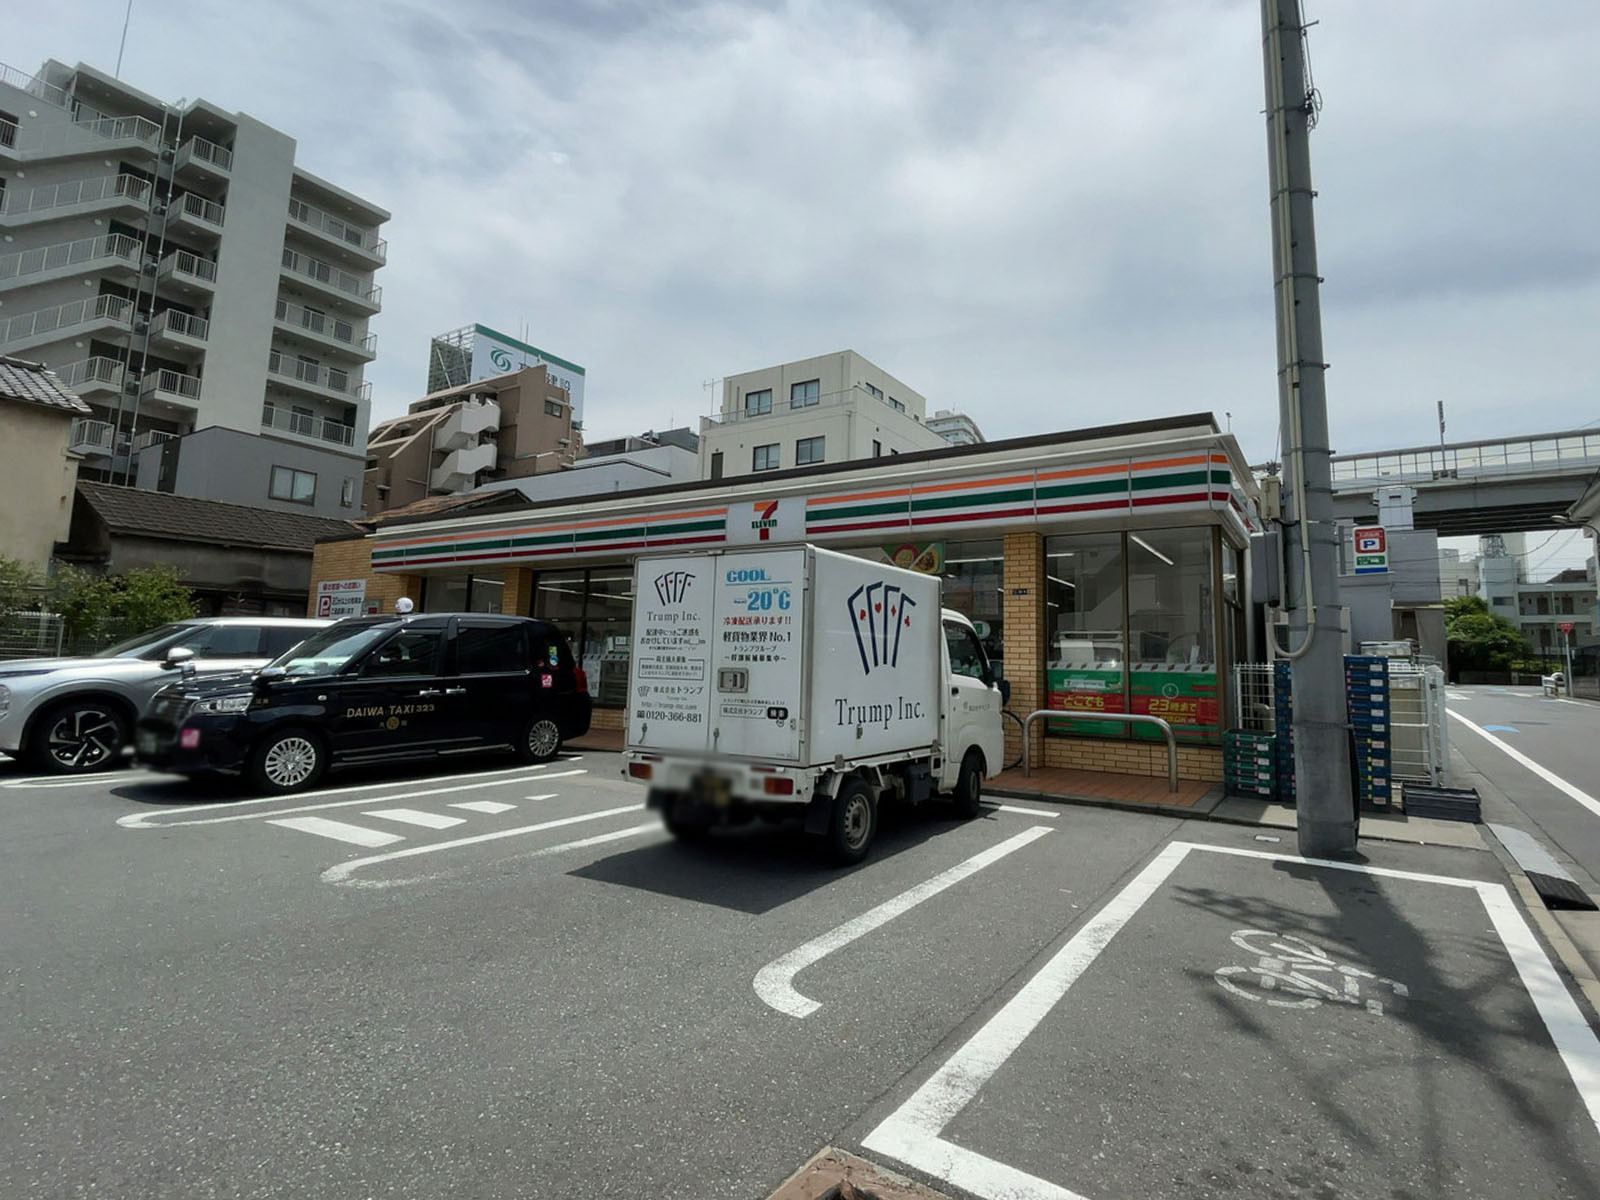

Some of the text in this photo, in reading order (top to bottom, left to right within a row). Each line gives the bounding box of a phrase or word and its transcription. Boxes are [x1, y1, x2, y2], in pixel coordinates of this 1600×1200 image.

[1363, 540, 1376, 549] P
[726, 568, 771, 583] COOL
[647, 611, 701, 624] Trump Inc.
[346, 706, 384, 718] DAIWA
[389, 704, 414, 715] TAXI
[835, 697, 925, 729] Trump Inc.
